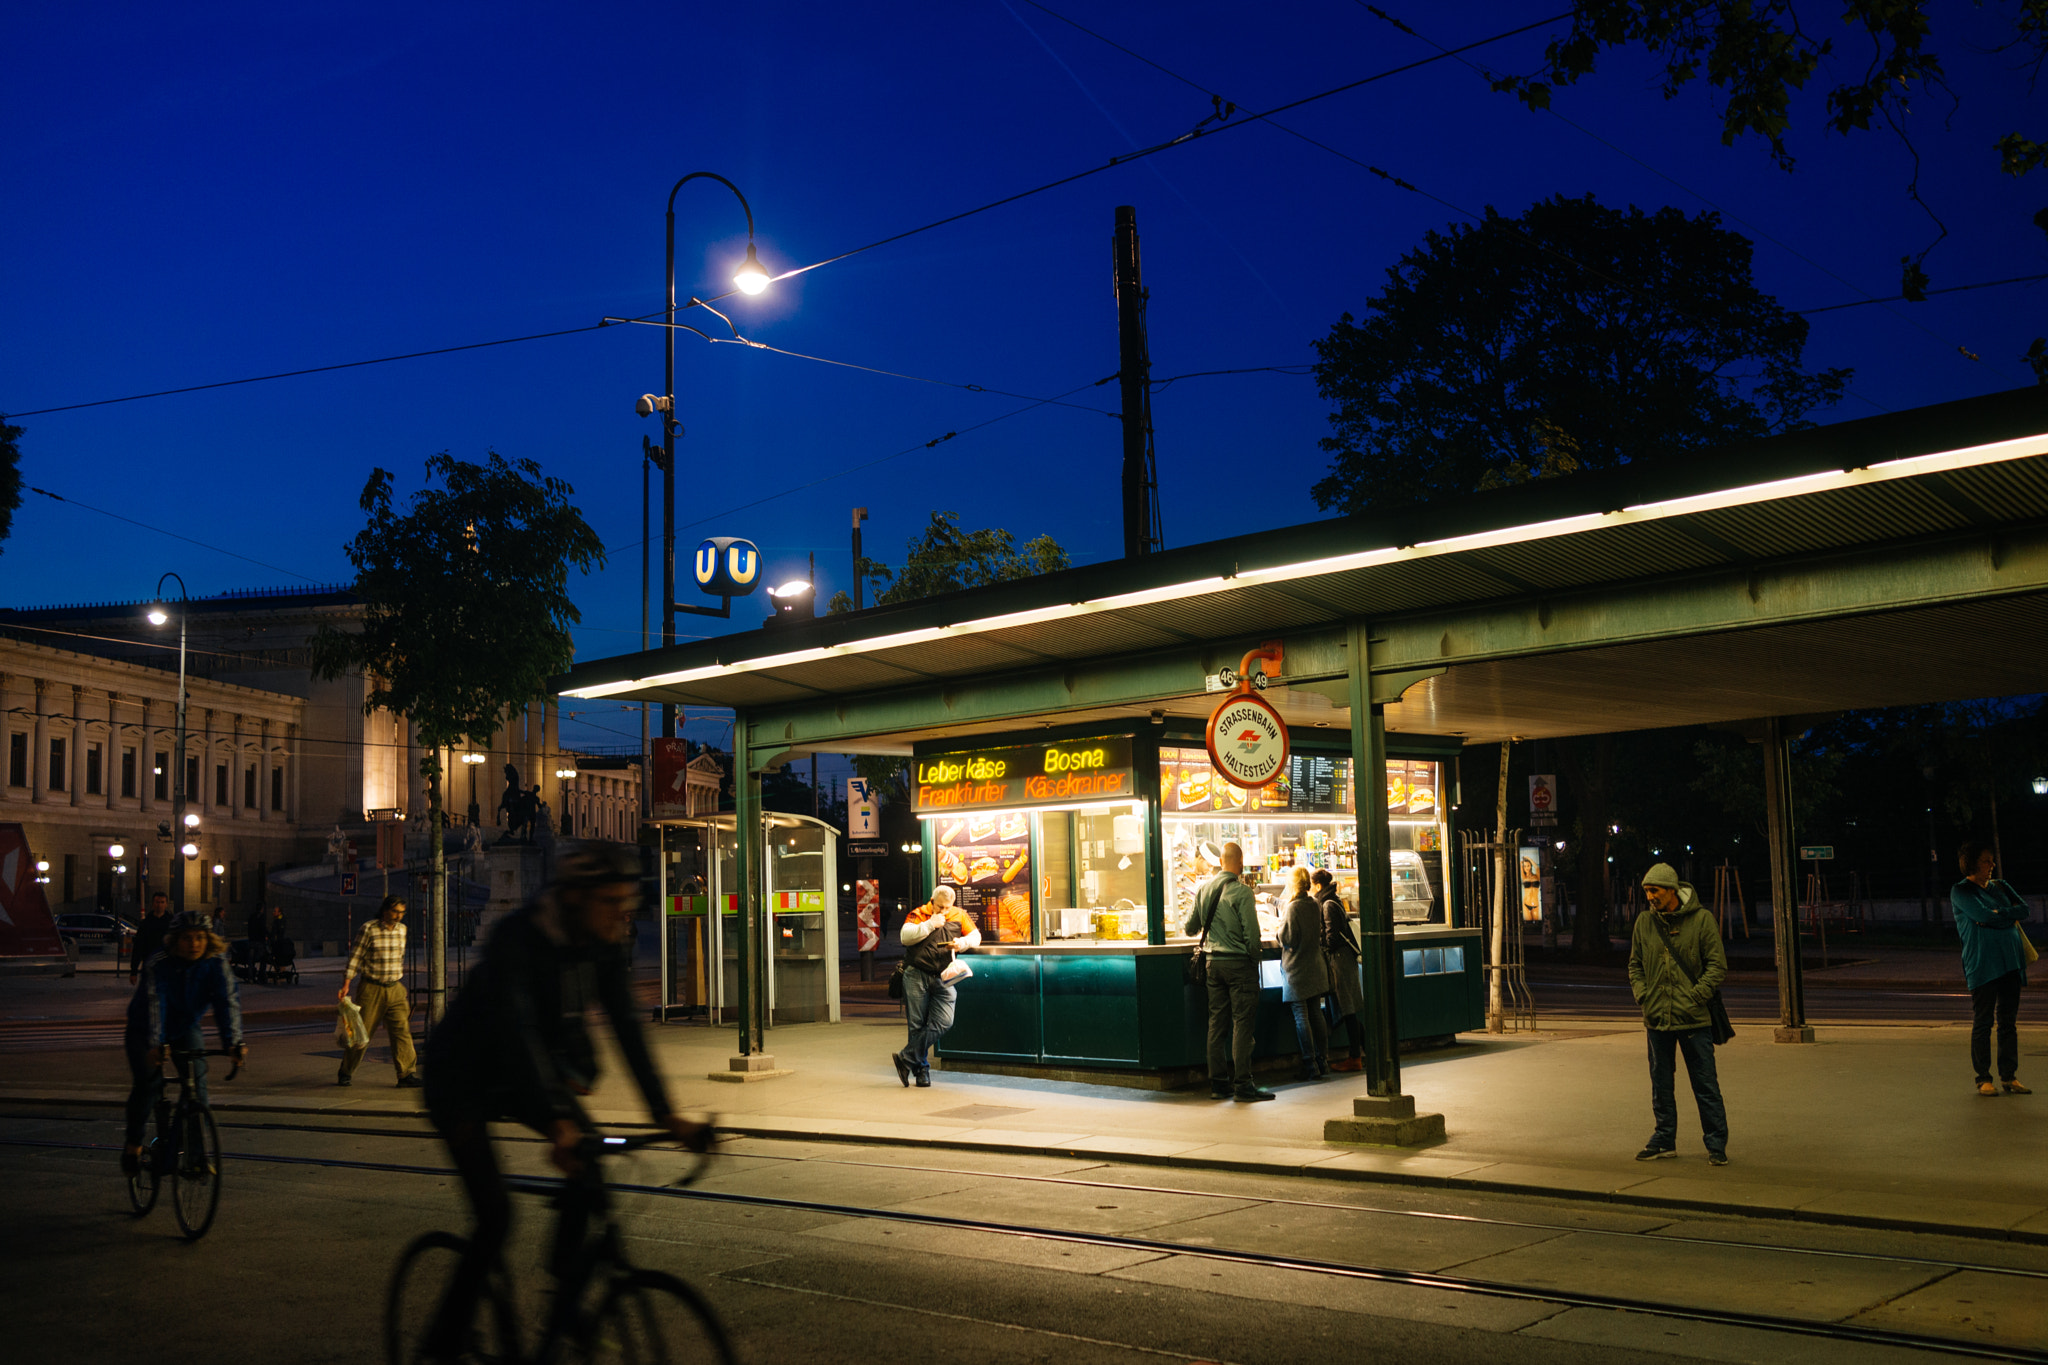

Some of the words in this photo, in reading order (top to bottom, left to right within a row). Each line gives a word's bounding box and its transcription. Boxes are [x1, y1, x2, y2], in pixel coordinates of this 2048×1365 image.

[696, 549, 715, 584] U
[729, 547, 756, 584] U
[1220, 670, 1234, 684] 46
[1255, 674, 1267, 687] 49
[1219, 708, 1278, 740] STRASSENBAHN
[918, 758, 1006, 784] Leberkäse
[1044, 749, 1104, 773] Bosna
[1223, 751, 1277, 778] HALTESTELLE
[918, 780, 1008, 807] Frankfurter
[1024, 771, 1126, 798] Käsekrainer
